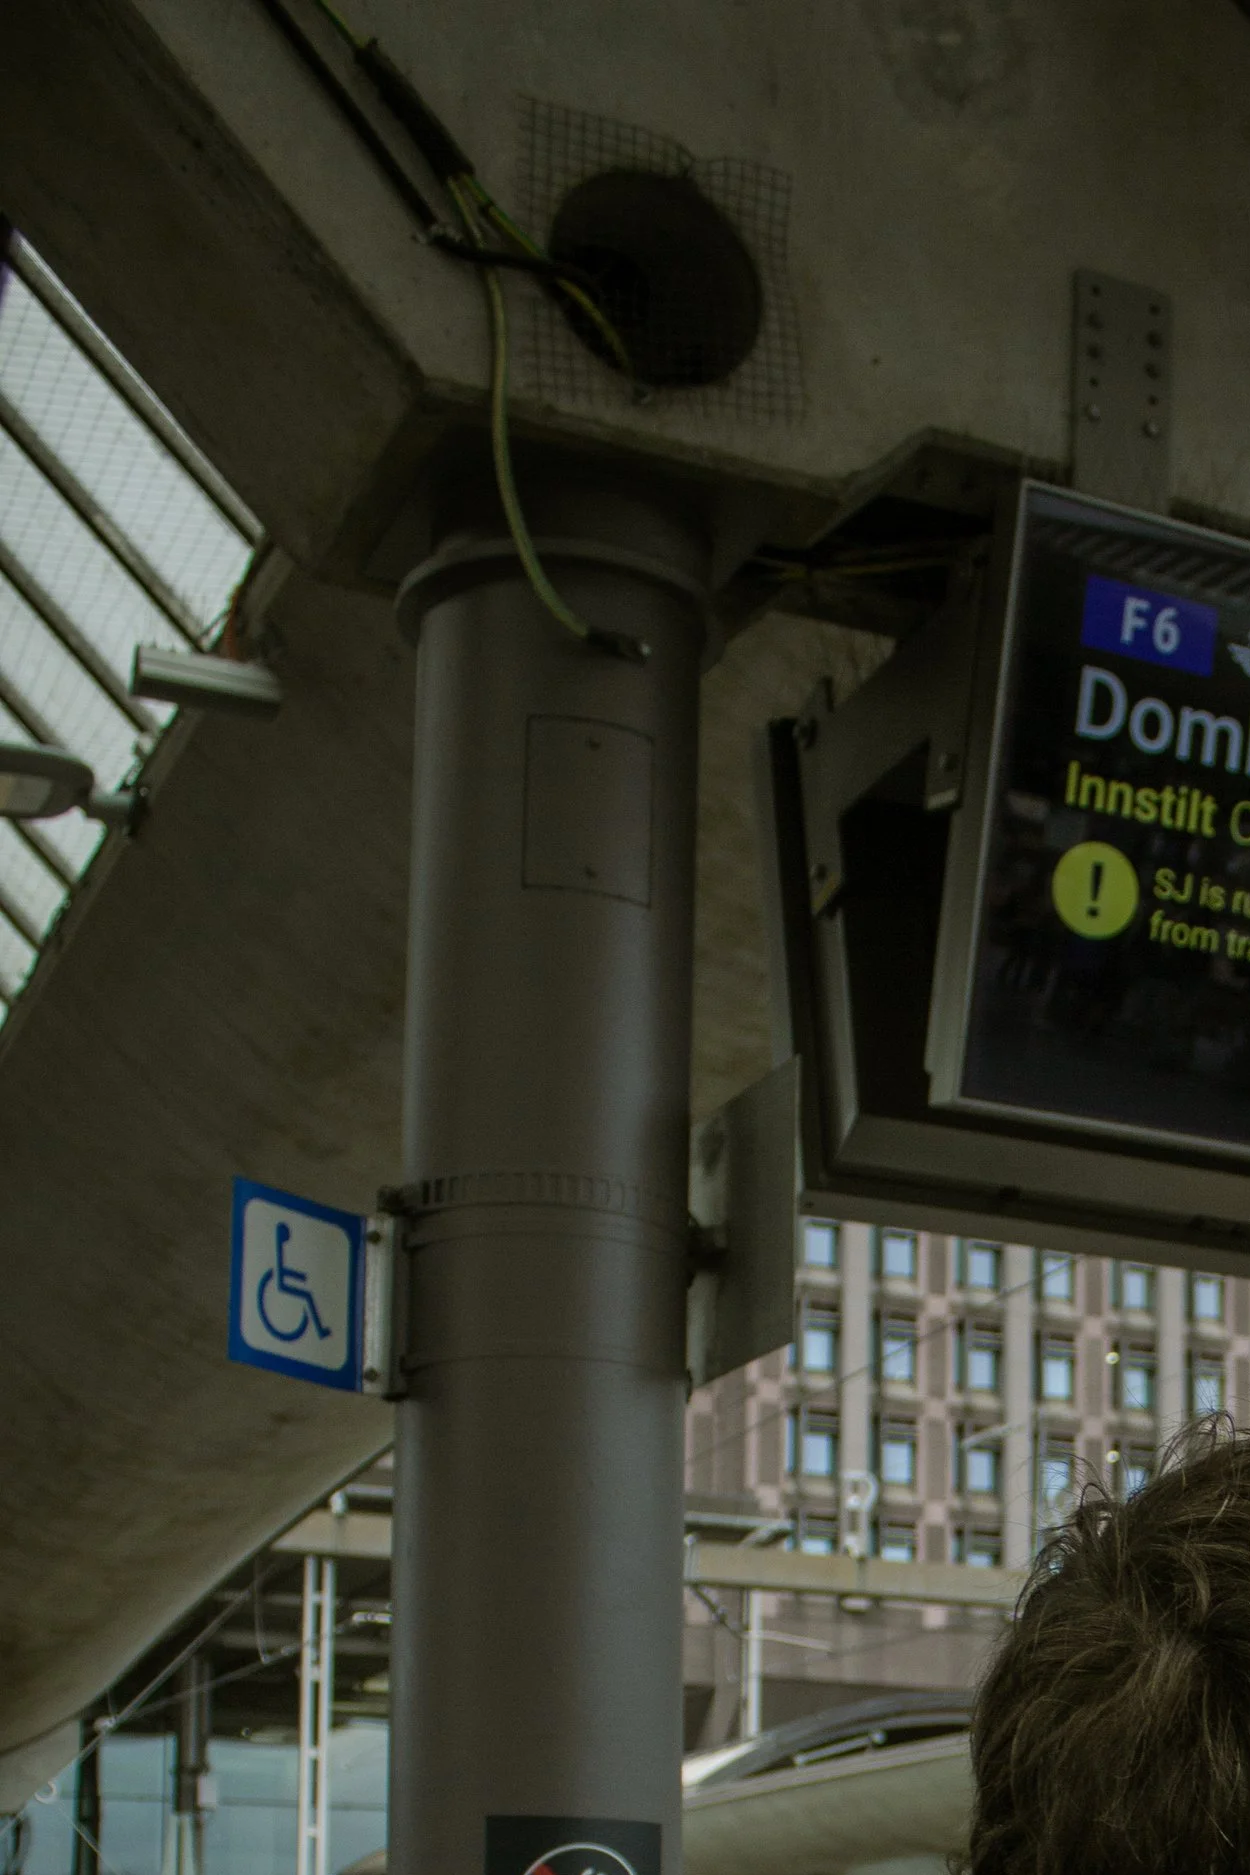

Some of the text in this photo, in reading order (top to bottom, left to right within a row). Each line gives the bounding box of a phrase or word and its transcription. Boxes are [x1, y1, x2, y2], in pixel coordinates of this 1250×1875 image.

[1119, 595, 1182, 656] F6
[1064, 759, 1219, 839] Innstilt
[1152, 866, 1196, 905] SJ
[1199, 876, 1228, 913] is
[1149, 909, 1221, 953] from
